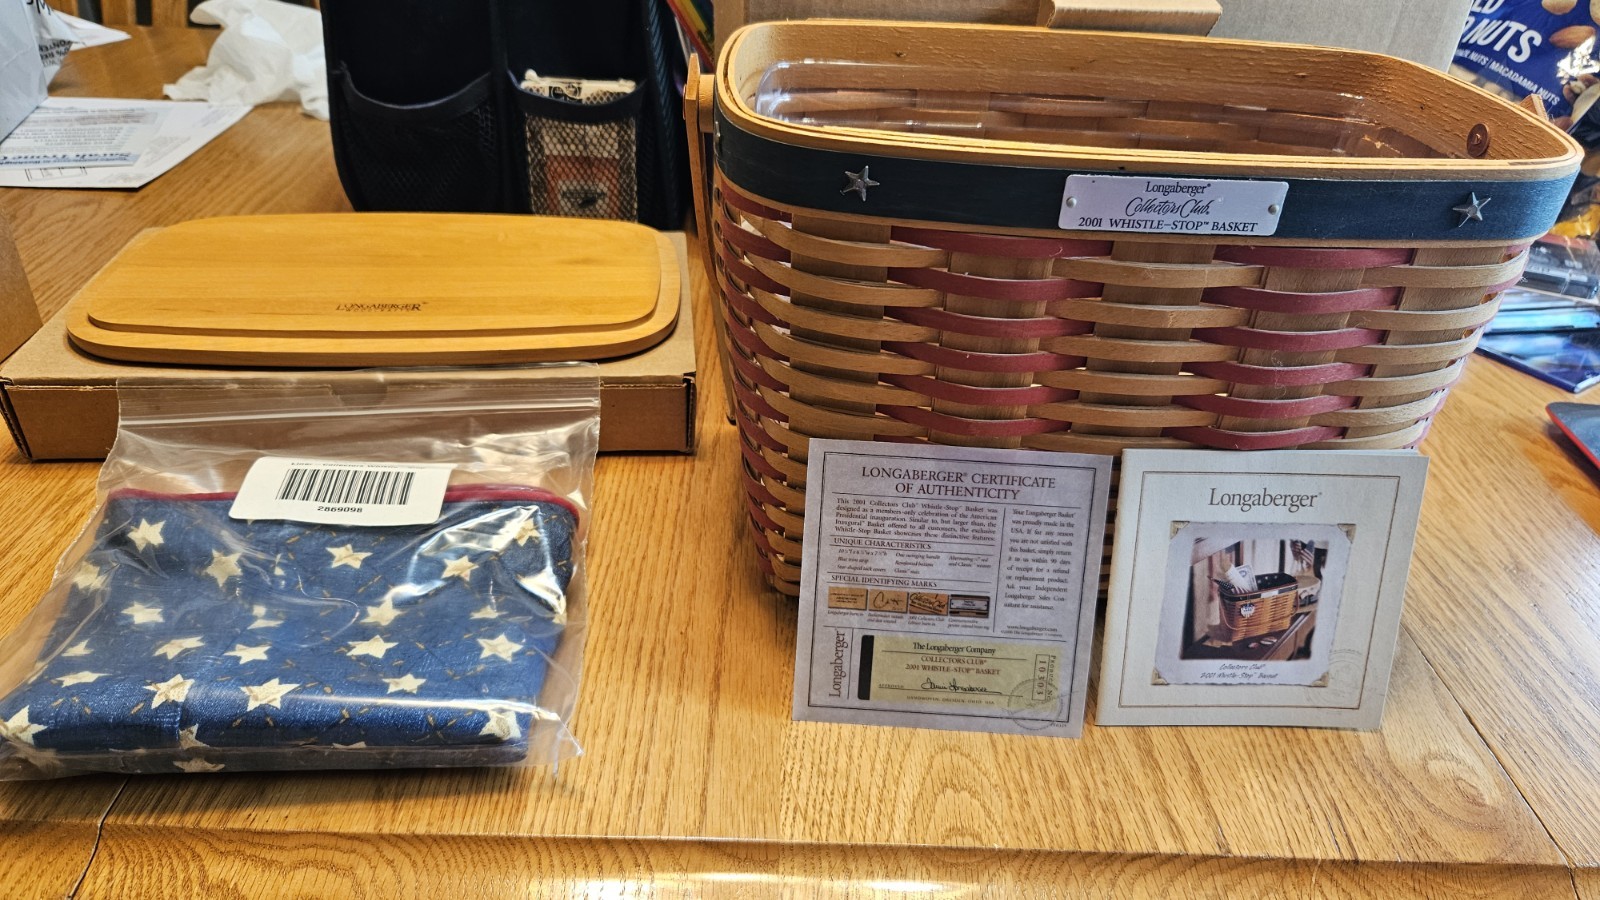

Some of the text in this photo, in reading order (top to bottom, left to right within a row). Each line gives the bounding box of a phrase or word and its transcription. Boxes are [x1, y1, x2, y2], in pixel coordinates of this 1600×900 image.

[1462, 17, 1543, 63] NUTS
[1468, 51, 1489, 66] NUTS
[1489, 60, 1538, 93] MACADAMIA
[1537, 87, 1561, 106] NUTS
[1125, 196, 1182, 217] Collectors
[1078, 217, 1103, 228] 2001
[1211, 221, 1258, 233] BASKET
[971, 473, 1056, 489] CERTIFICATE
[895, 482, 1021, 500] OF AUTHENTICITY
[836, 505, 860, 513] designed
[965, 505, 984, 513] Basket
[1025, 510, 1057, 518] Longaberger
[835, 512, 868, 520] Presidential
[1022, 519, 1042, 527] proudly
[833, 537, 932, 550] UNIQUE CHARACTERISTICS
[831, 574, 937, 588] SPECIAL IDENTIFYING MARKS
[1035, 585, 1068, 593] Independent
[1004, 592, 1036, 600] Longaberger
[912, 641, 996, 656] The Longaberger Company
[921, 656, 965, 665] COLLECTORS
[975, 667, 1001, 676] BASKET
